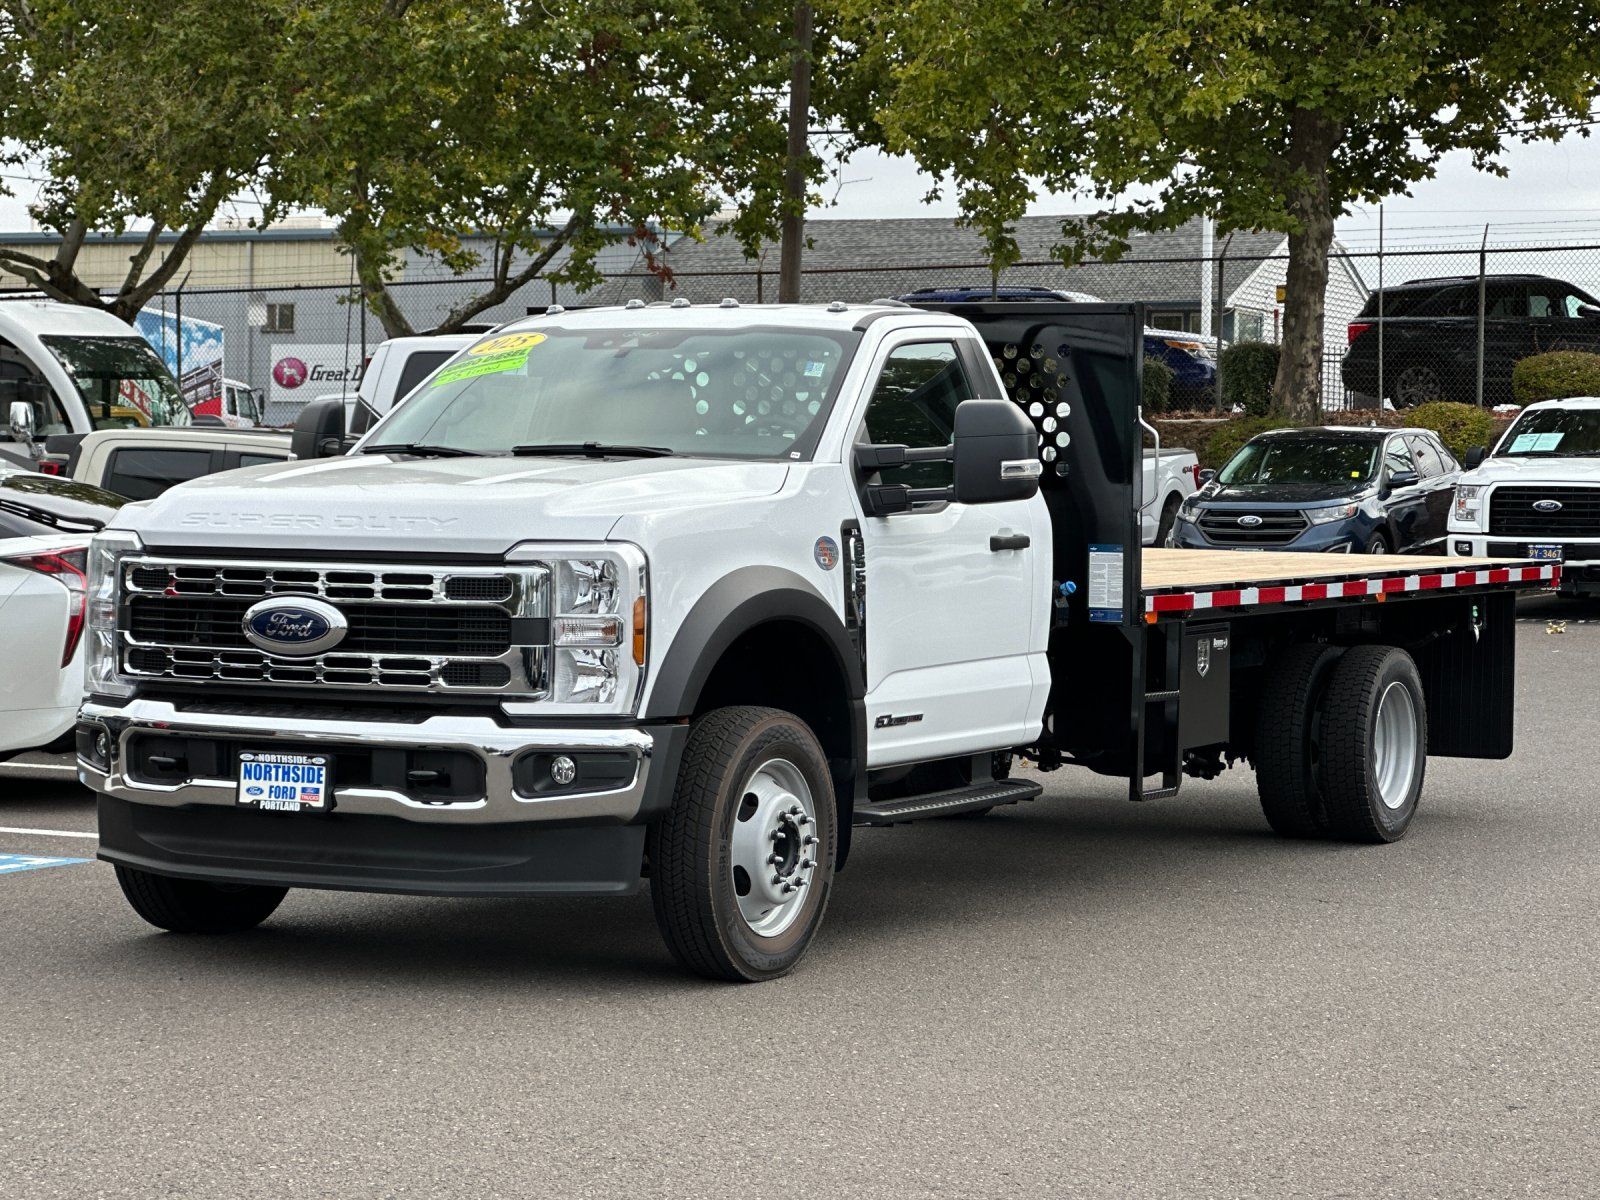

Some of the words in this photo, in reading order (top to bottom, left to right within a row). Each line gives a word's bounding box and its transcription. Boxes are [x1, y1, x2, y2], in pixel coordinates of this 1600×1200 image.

[309, 364, 350, 382] Great
[181, 511, 324, 529] SUPER
[331, 514, 460, 532] DUTY
[265, 612, 314, 637] Ford
[258, 754, 308, 764] NORTHSIDE
[243, 763, 324, 784] NORTHSIDE
[268, 785, 296, 800] FORD
[259, 800, 300, 811] PORTLAND
